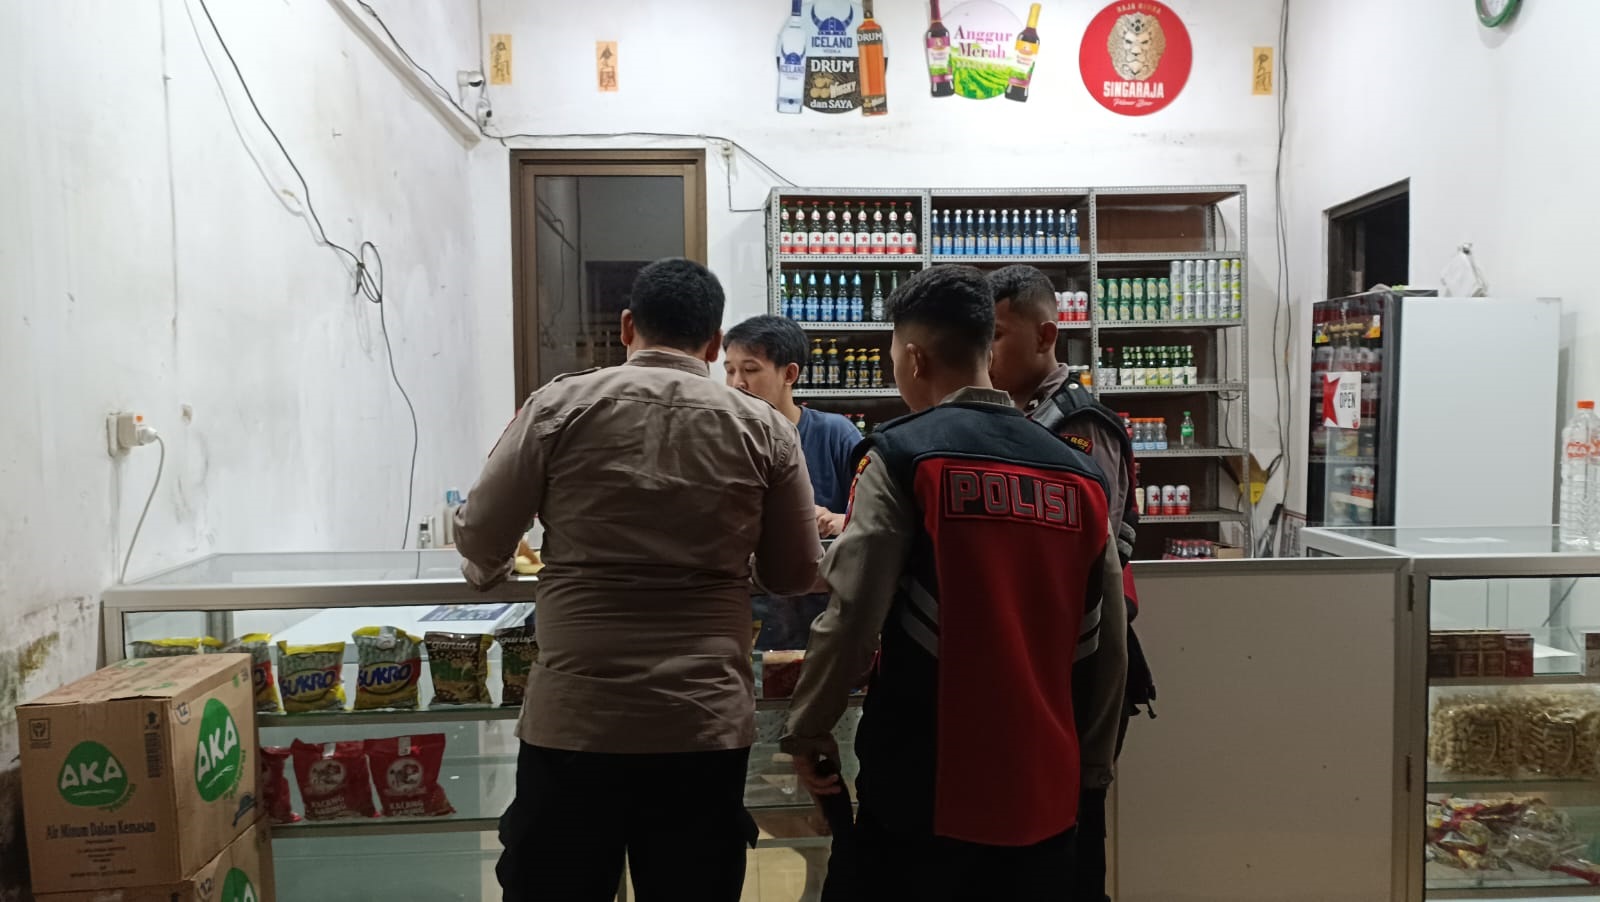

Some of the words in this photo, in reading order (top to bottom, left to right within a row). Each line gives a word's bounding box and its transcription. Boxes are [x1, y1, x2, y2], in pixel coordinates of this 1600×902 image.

[811, 36, 853, 48] ICELAND
[857, 32, 883, 42] DRUM
[954, 25, 1013, 43] Anggur
[958, 42, 1006, 59] Merah
[810, 60, 855, 73] DRUM
[1103, 81, 1164, 98] SINGARAJA
[810, 100, 828, 108] dan
[829, 99, 854, 109] SAYA
[1339, 391, 1356, 409] OPEN
[949, 470, 1077, 526] POLISI
[431, 641, 478, 651] garuda
[280, 670, 336, 698] SUKRO
[358, 663, 412, 688] SUKRO
[198, 715, 237, 782] AKA
[61, 756, 123, 790] AKA
